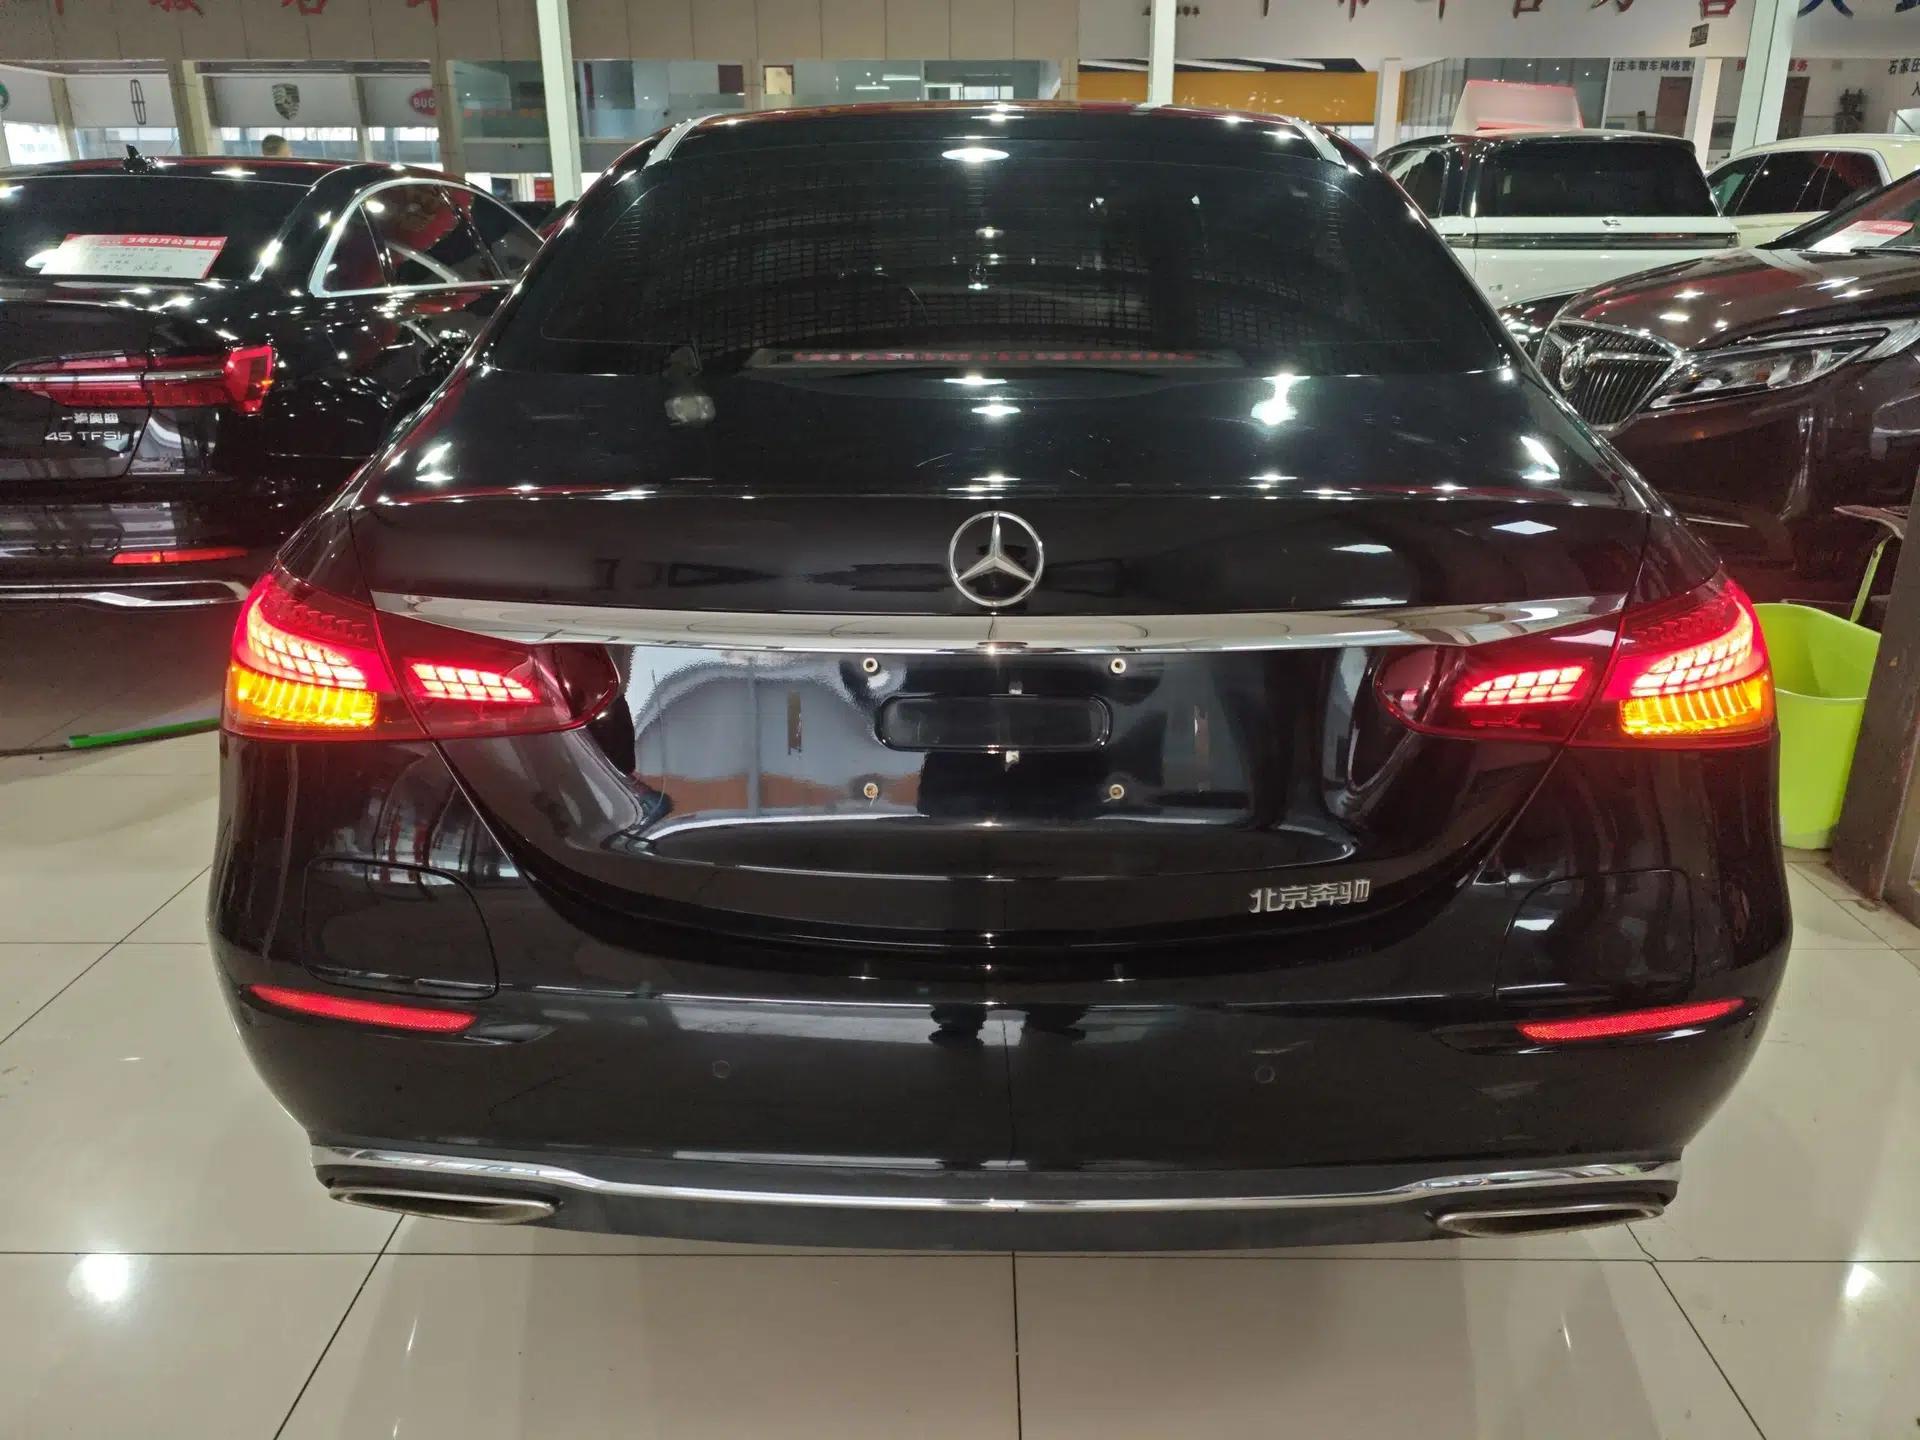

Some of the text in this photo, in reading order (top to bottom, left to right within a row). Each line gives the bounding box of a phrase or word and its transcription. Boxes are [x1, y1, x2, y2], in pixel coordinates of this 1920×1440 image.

[44, 431, 121, 441] 45 TFSI
[1249, 879, 1371, 914] 北京奔驰
